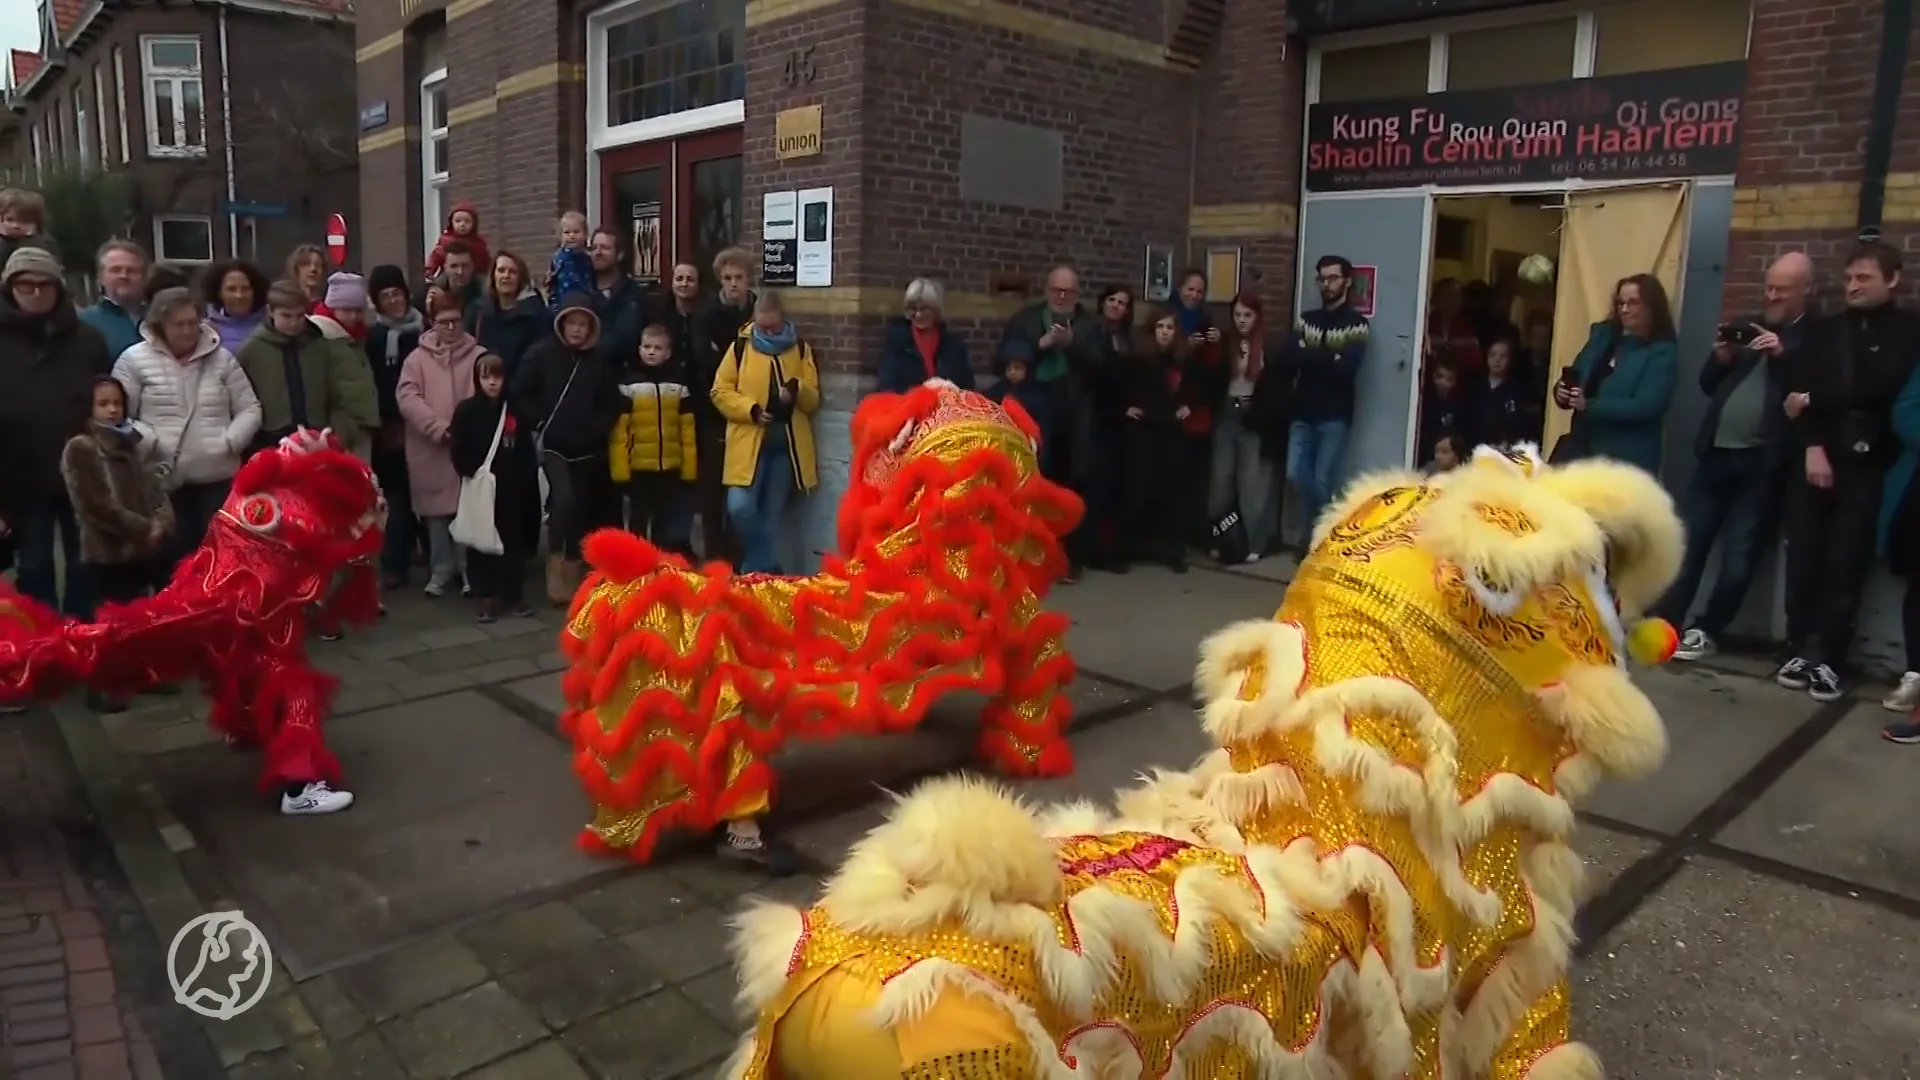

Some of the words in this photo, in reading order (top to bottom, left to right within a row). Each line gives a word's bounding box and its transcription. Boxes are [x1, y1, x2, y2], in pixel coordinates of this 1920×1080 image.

[784, 45, 817, 87] 45
[1659, 97, 1740, 123] Gong
[1332, 114, 1400, 142] Kung
[1410, 108, 1445, 135] Fu
[1449, 122, 1494, 143] Rou
[1502, 118, 1567, 143] Quan
[779, 132, 817, 152] union
[1309, 138, 1411, 170] Shaolin
[1423, 132, 1562, 164] Centrum
[1576, 119, 1735, 155] Haarlem
[1578, 159, 1596, 173] 06
